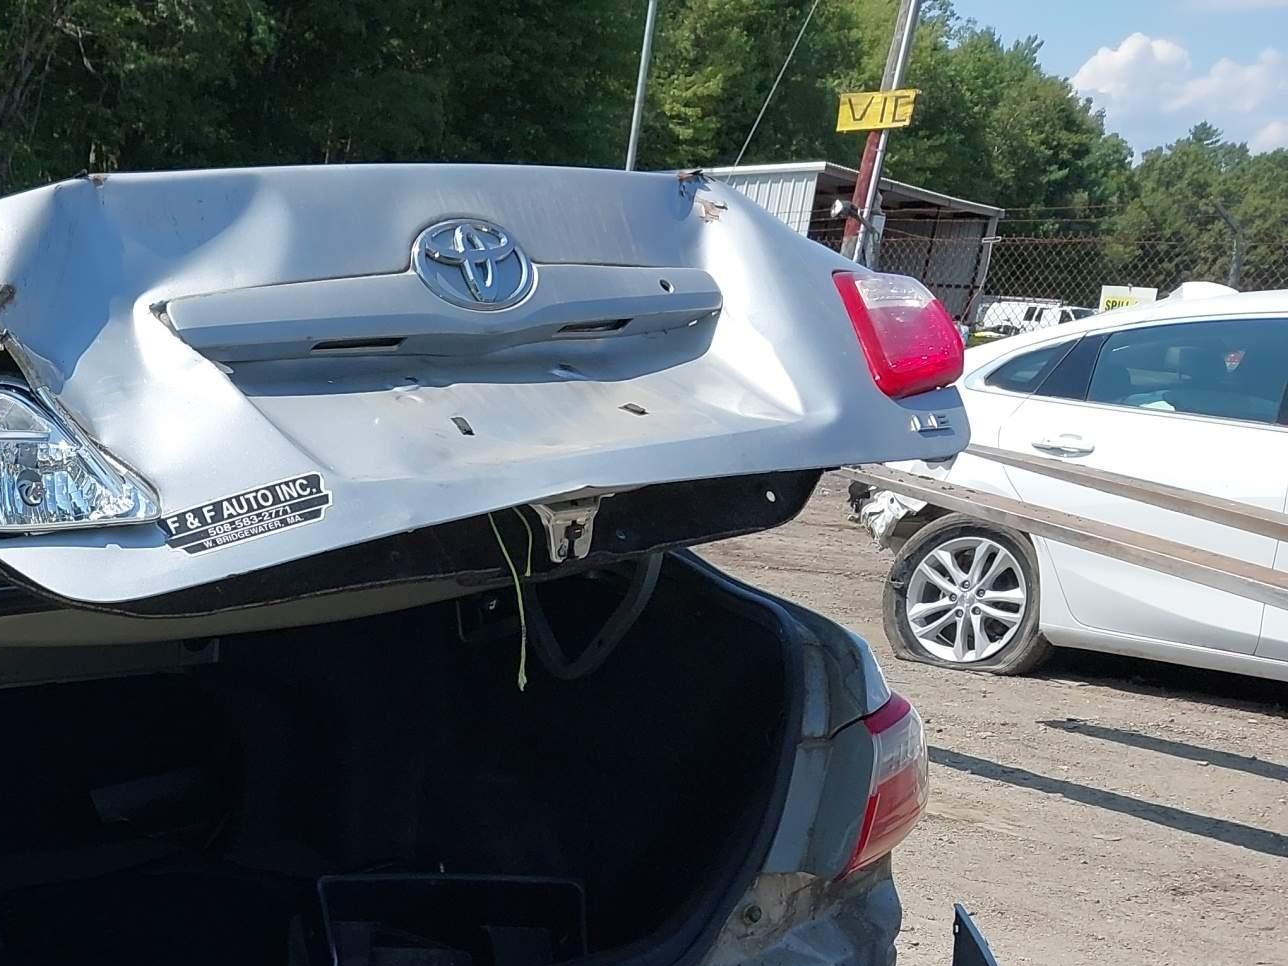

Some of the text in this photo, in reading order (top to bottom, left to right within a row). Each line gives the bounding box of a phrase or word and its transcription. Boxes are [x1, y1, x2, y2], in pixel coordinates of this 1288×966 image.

[910, 412, 953, 433] LE
[166, 478, 317, 535] F & F AUTO INC.
[207, 505, 292, 537] 508-583-2771
[203, 538, 216, 549] W.
